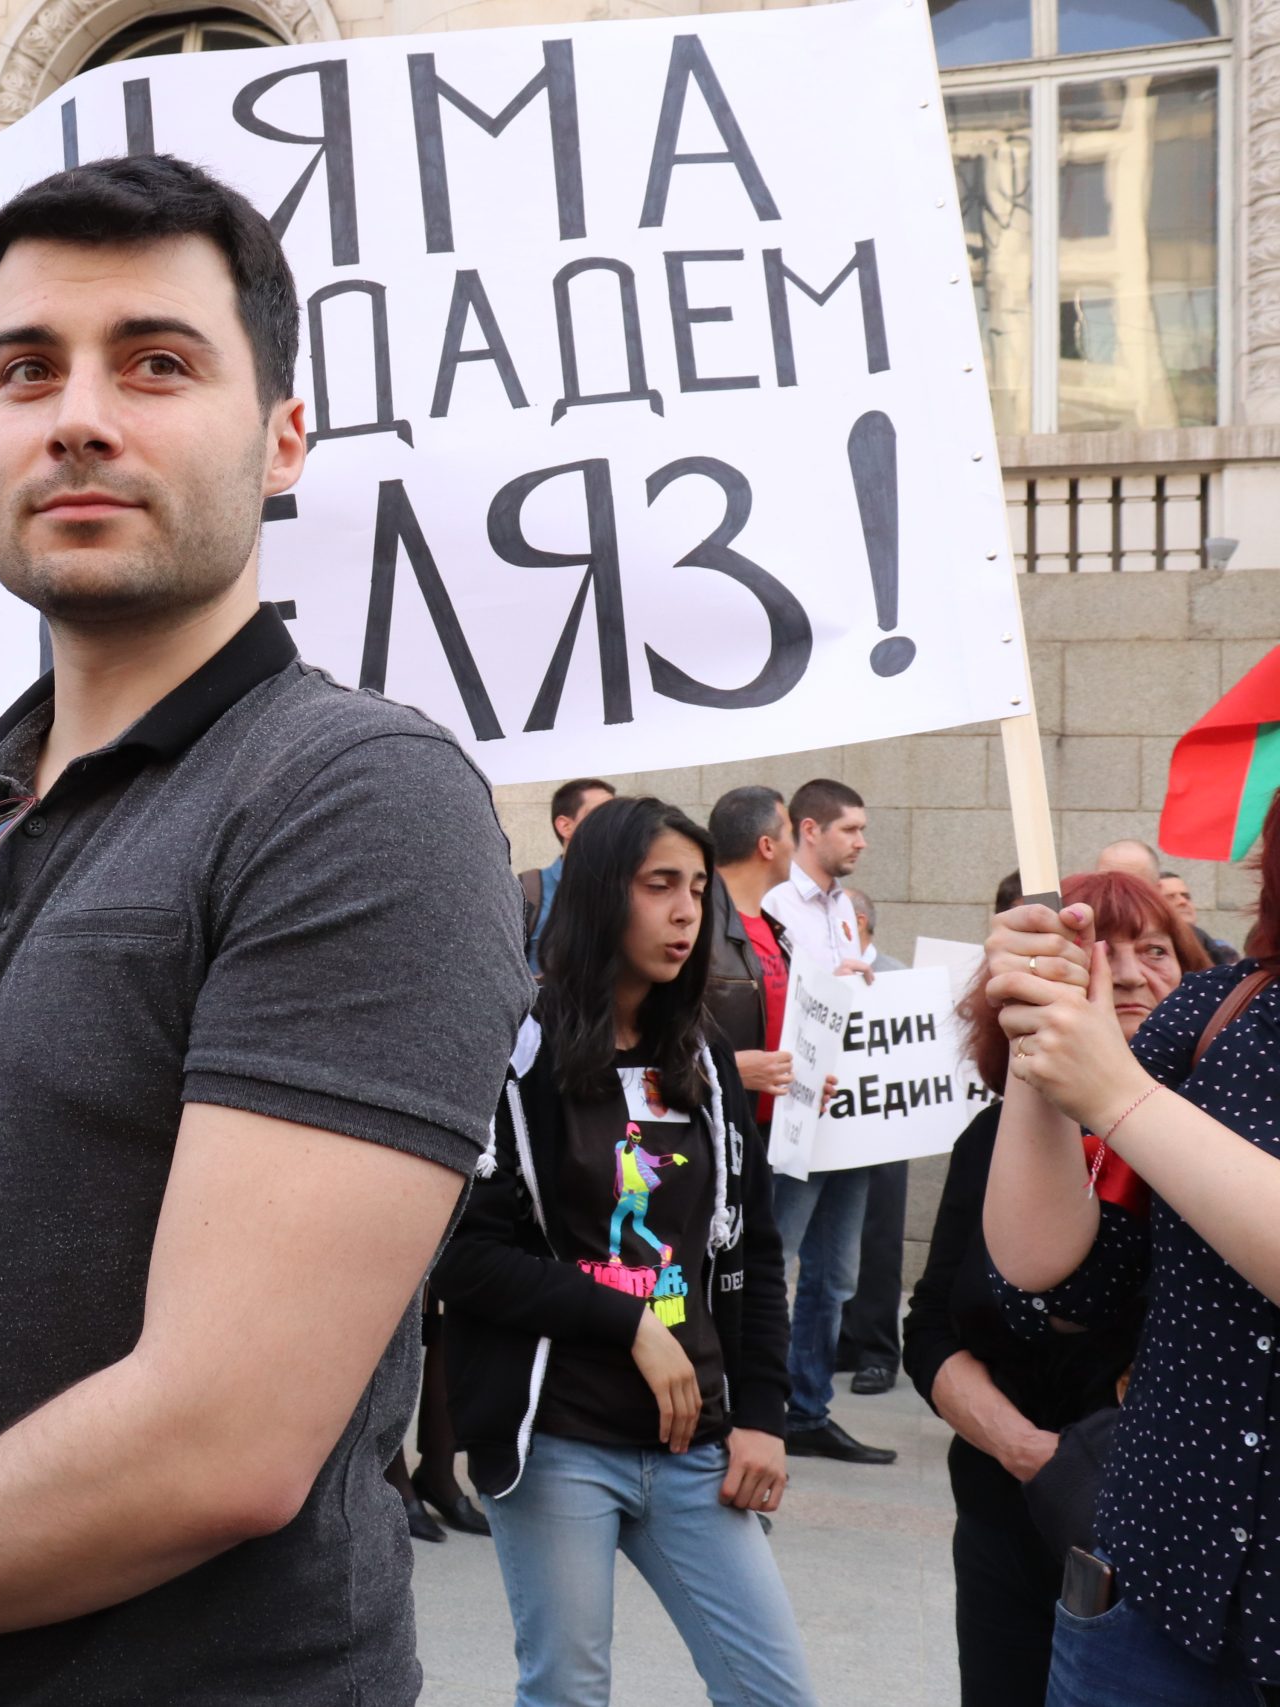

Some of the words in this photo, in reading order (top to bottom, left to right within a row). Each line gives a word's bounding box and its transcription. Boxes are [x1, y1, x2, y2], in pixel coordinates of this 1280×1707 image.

[39, 408, 917, 742] ЛЯЗ!
[828, 1011, 844, 1034] за
[843, 1011, 937, 1057] Един
[820, 1074, 954, 1120] аЕдин
